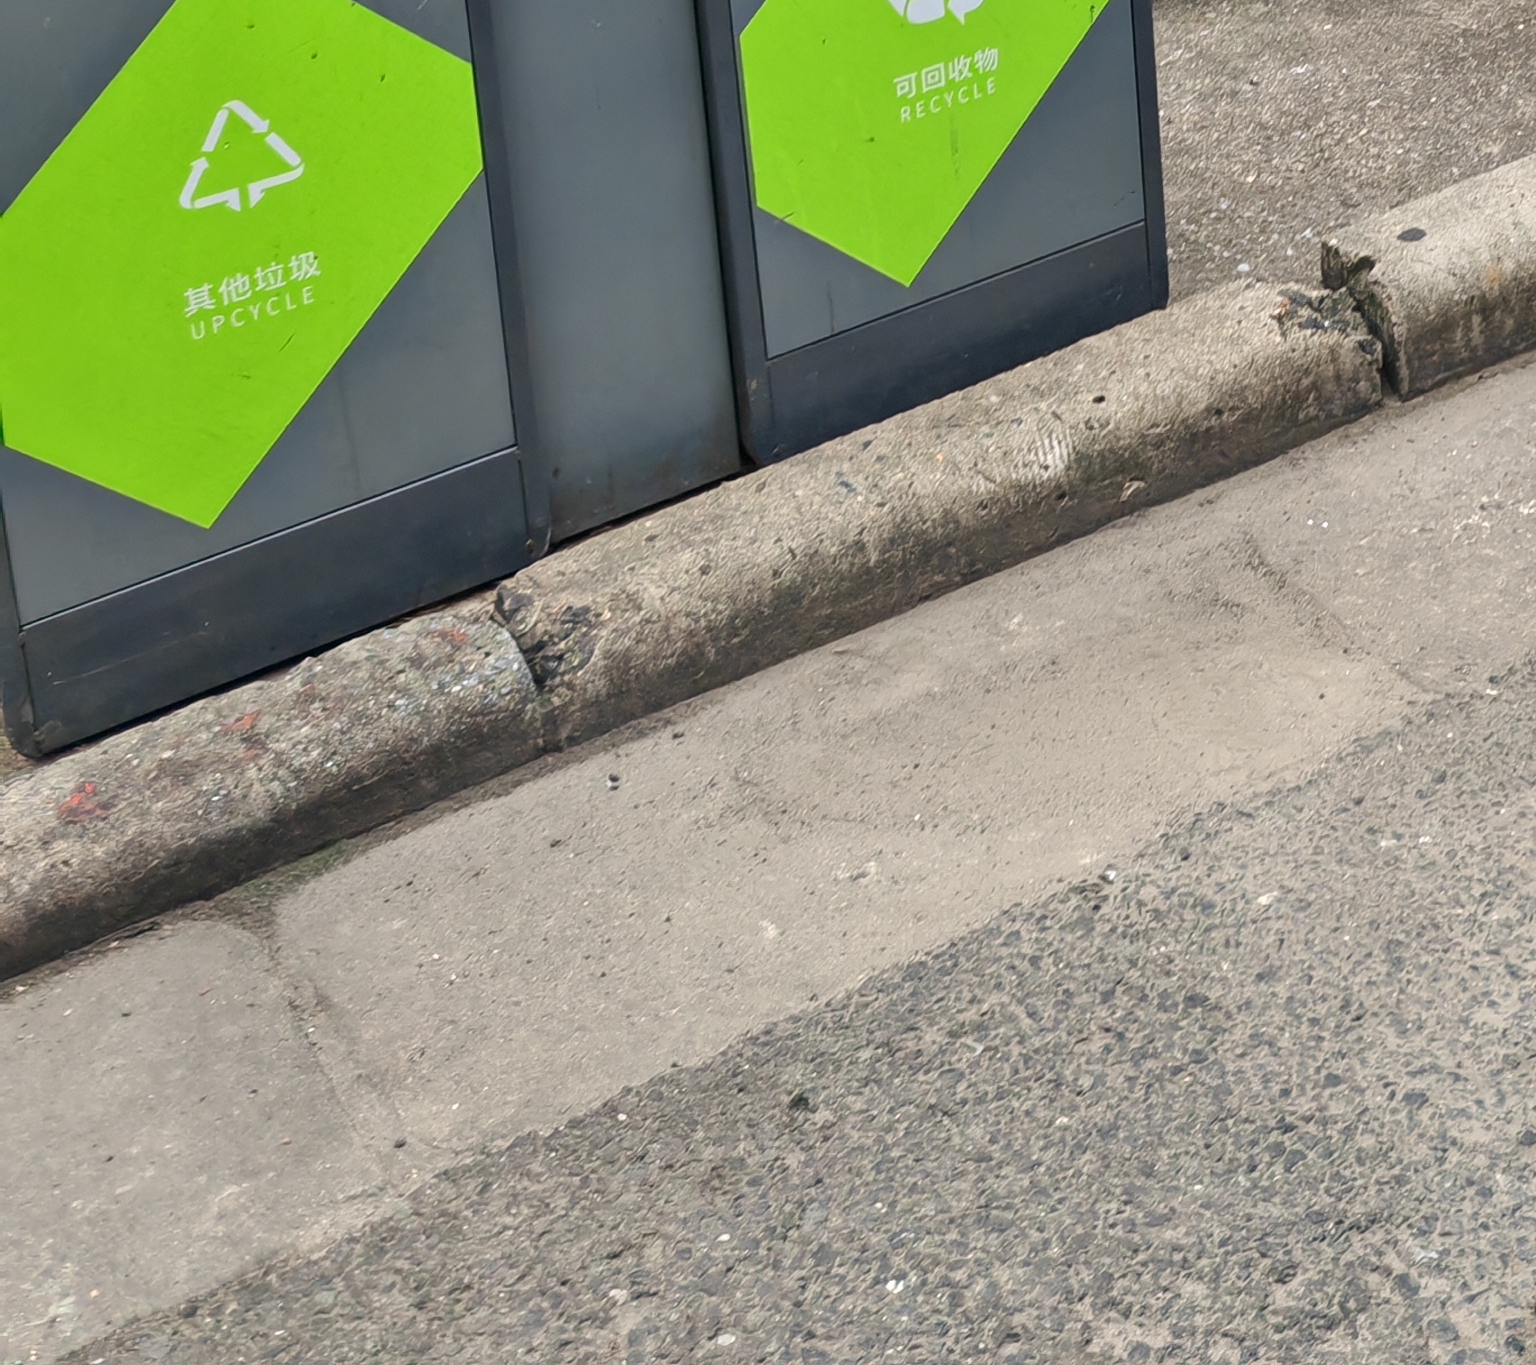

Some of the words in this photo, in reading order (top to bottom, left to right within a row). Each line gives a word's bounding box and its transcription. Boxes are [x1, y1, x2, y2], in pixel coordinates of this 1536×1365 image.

[892, 46, 1001, 100] 可回收物
[899, 76, 999, 124] RECYCLE
[183, 250, 322, 319] 其他垃圾
[188, 284, 316, 342] UPCYCLE
